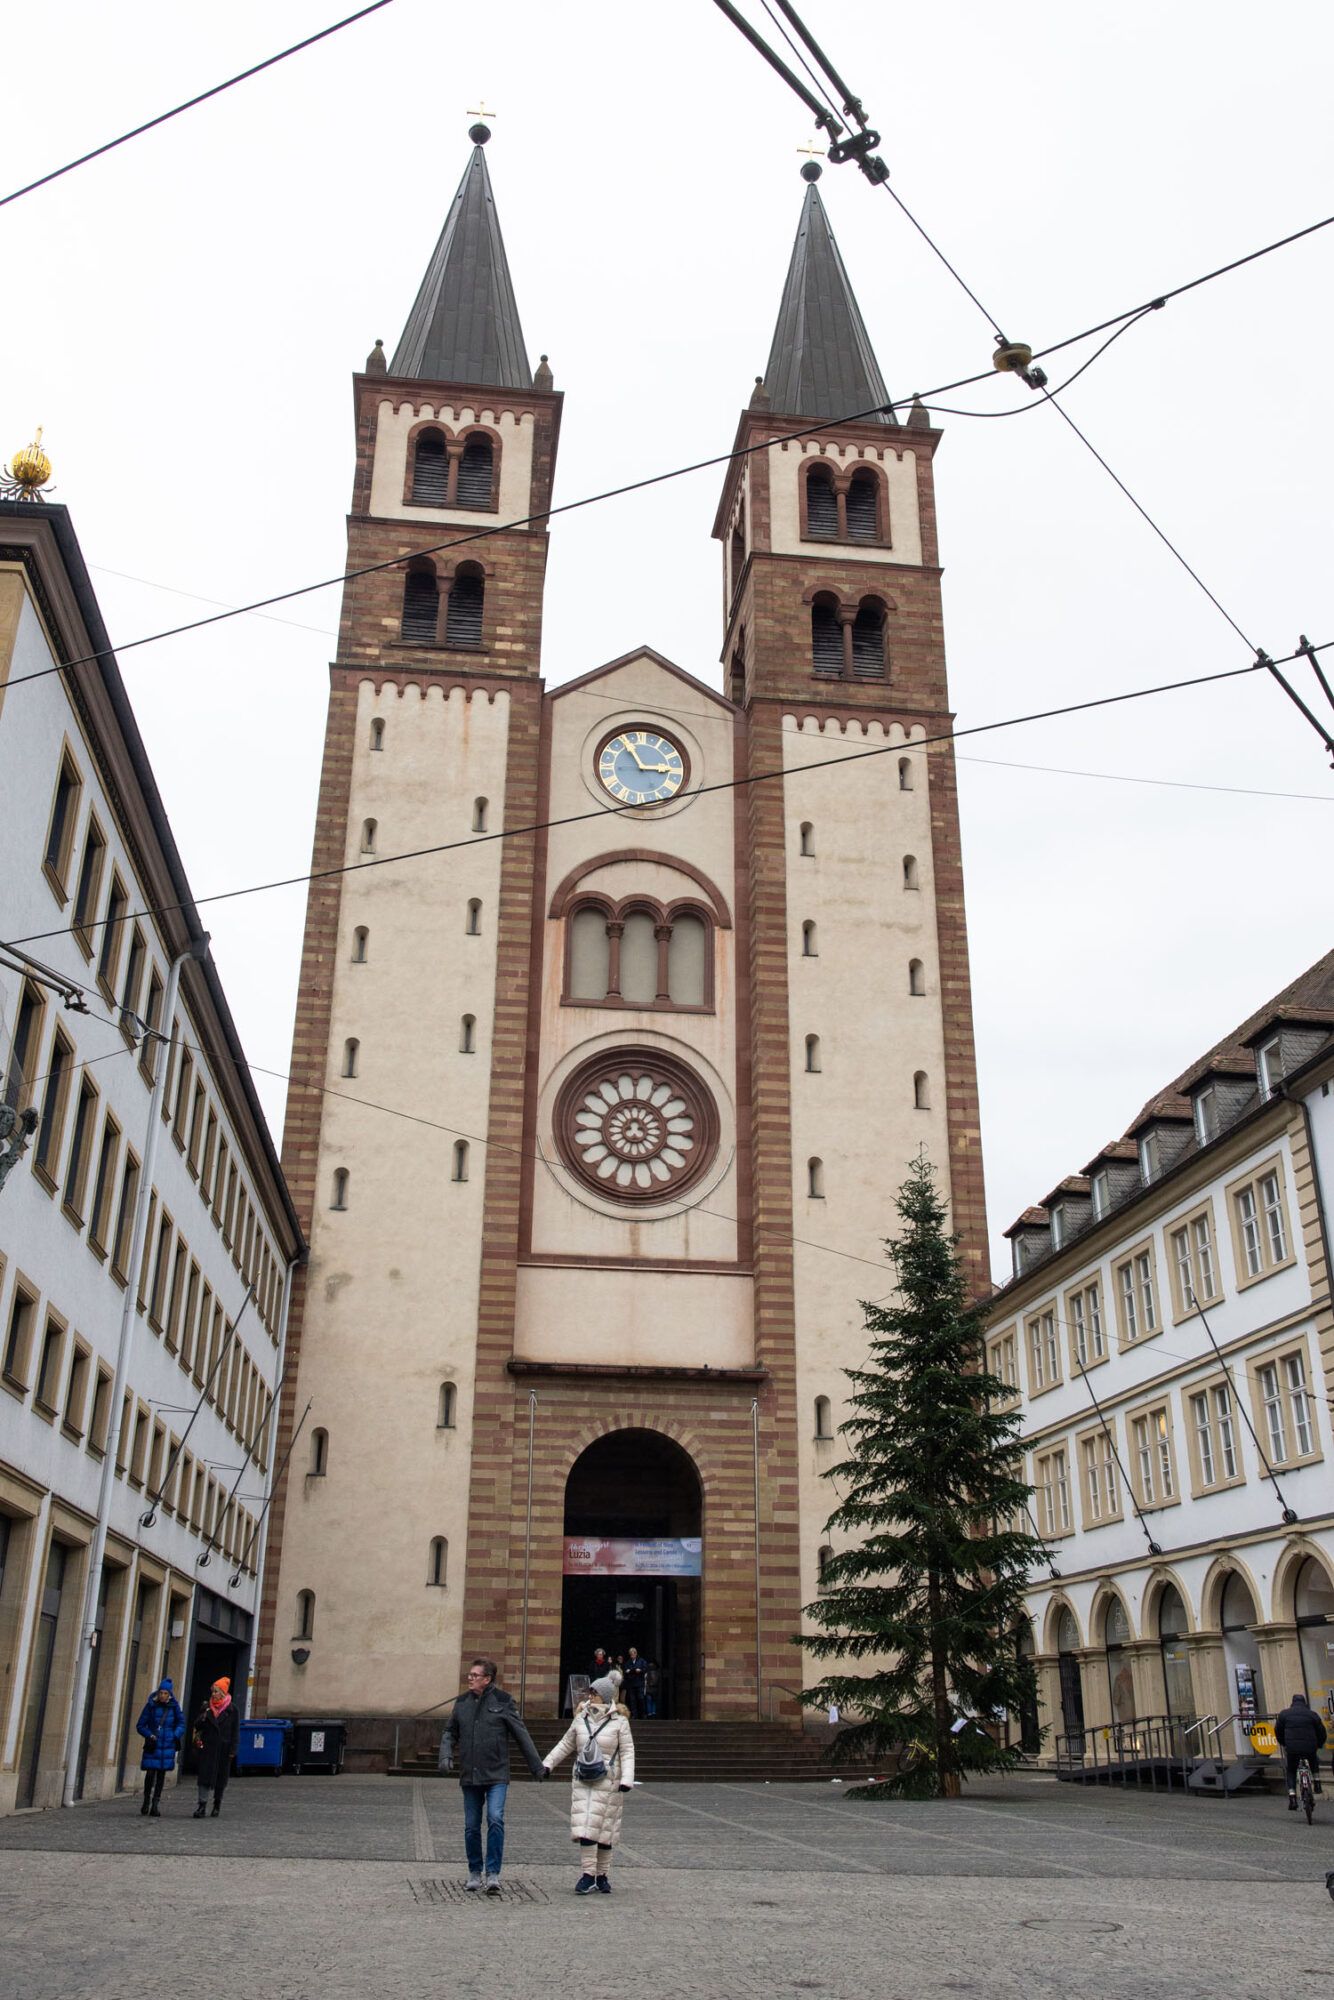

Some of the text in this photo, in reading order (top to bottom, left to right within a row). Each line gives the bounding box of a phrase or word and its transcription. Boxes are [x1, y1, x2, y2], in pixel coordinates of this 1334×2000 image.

[569, 1549, 591, 1560] Luzia
[1243, 1724, 1267, 1737] dom
[1257, 1733, 1278, 1746] info
